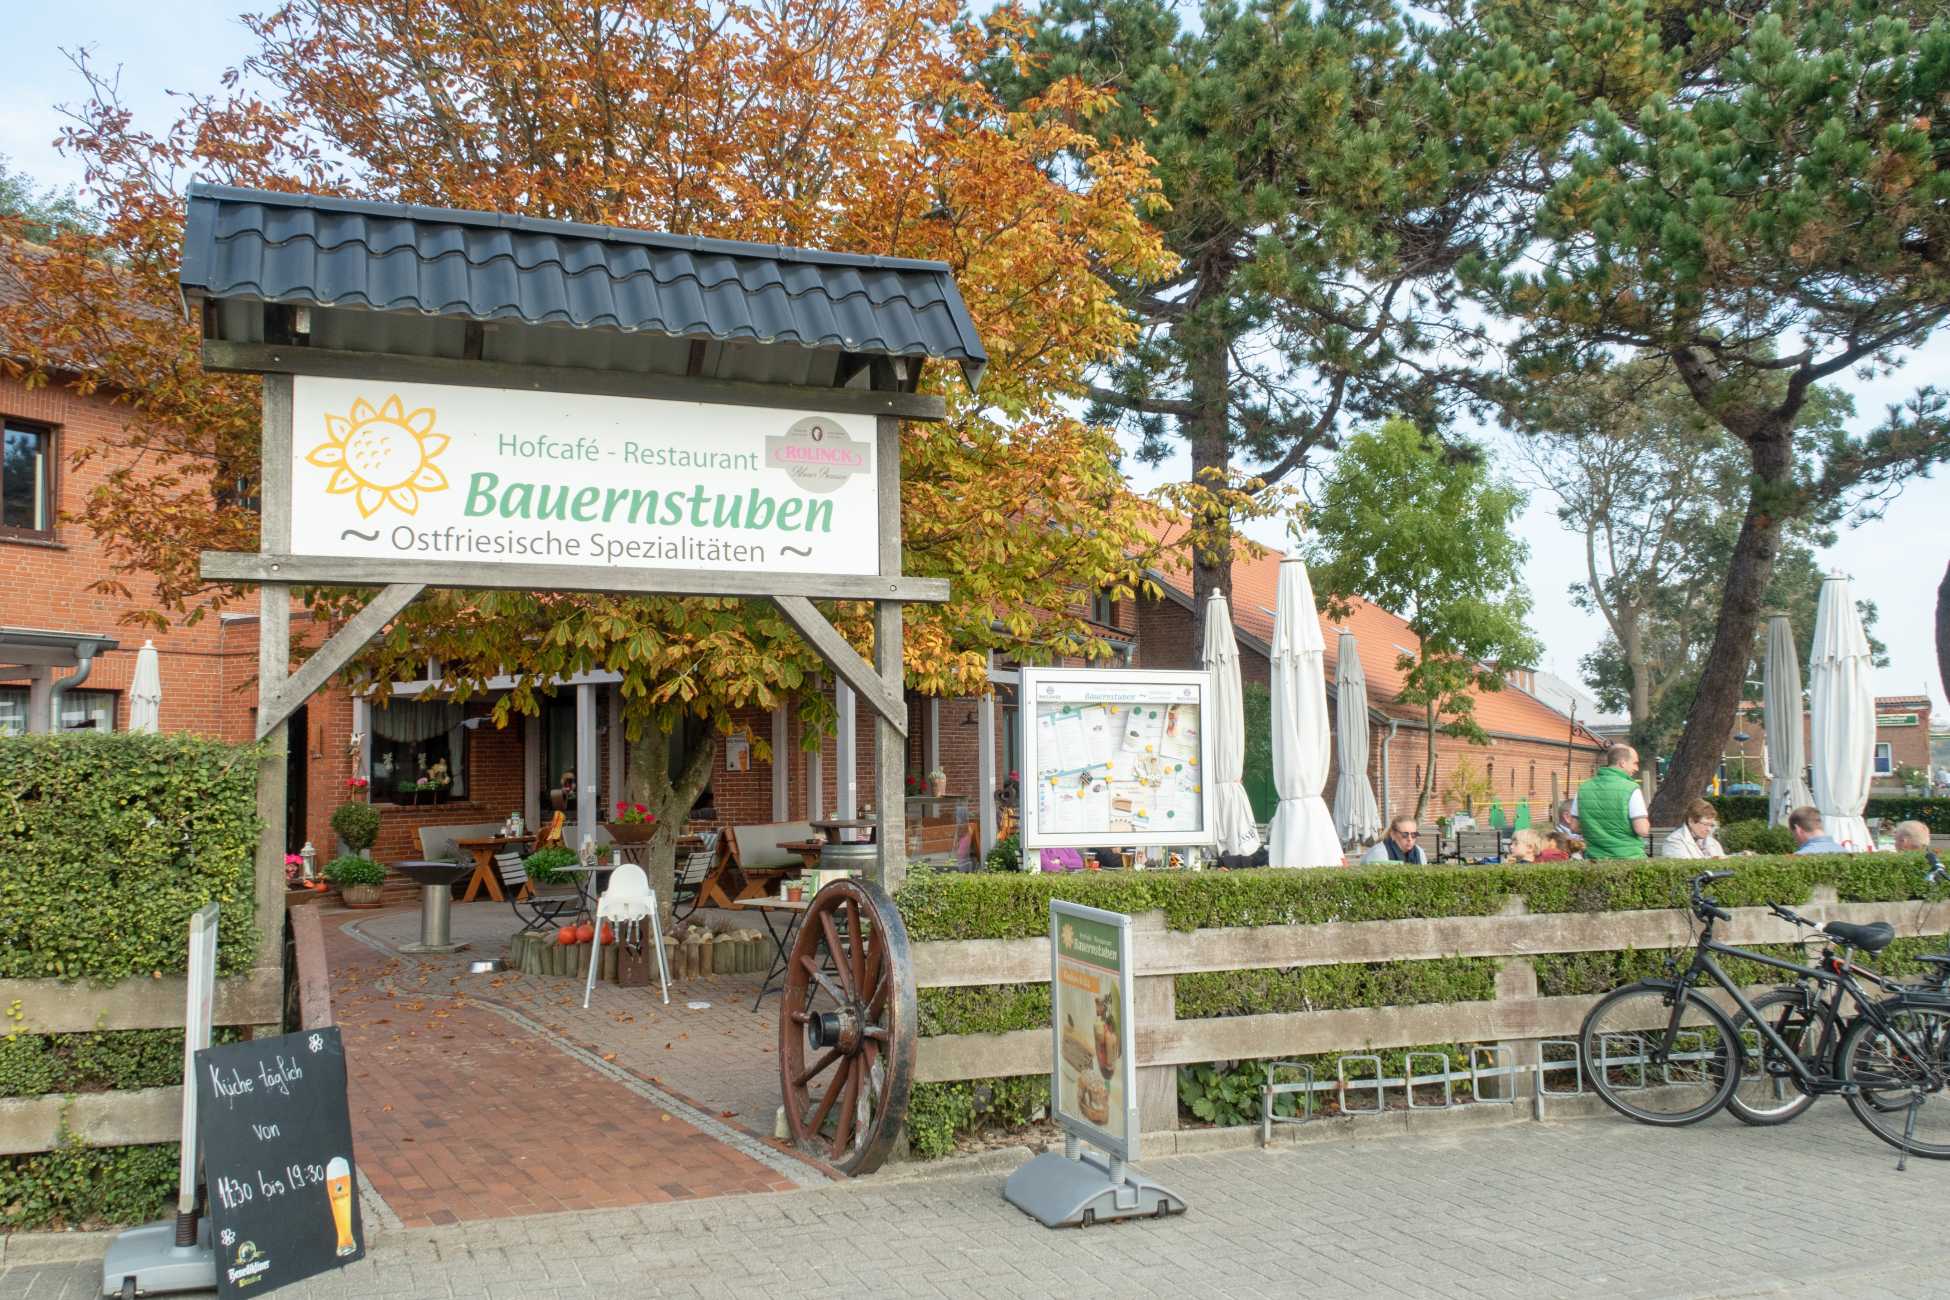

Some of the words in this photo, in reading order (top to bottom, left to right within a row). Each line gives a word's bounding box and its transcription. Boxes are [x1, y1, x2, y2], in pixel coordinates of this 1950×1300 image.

[498, 433, 600, 462] Hofcafé
[624, 441, 759, 471] Restaurant
[463, 471, 834, 533] Bauernstuben
[391, 525, 580, 557] Ostfriesische
[590, 533, 765, 564] Spezialitäten
[209, 1063, 254, 1098] Küche
[258, 1055, 303, 1096] täglich
[257, 1169, 285, 1198] bis
